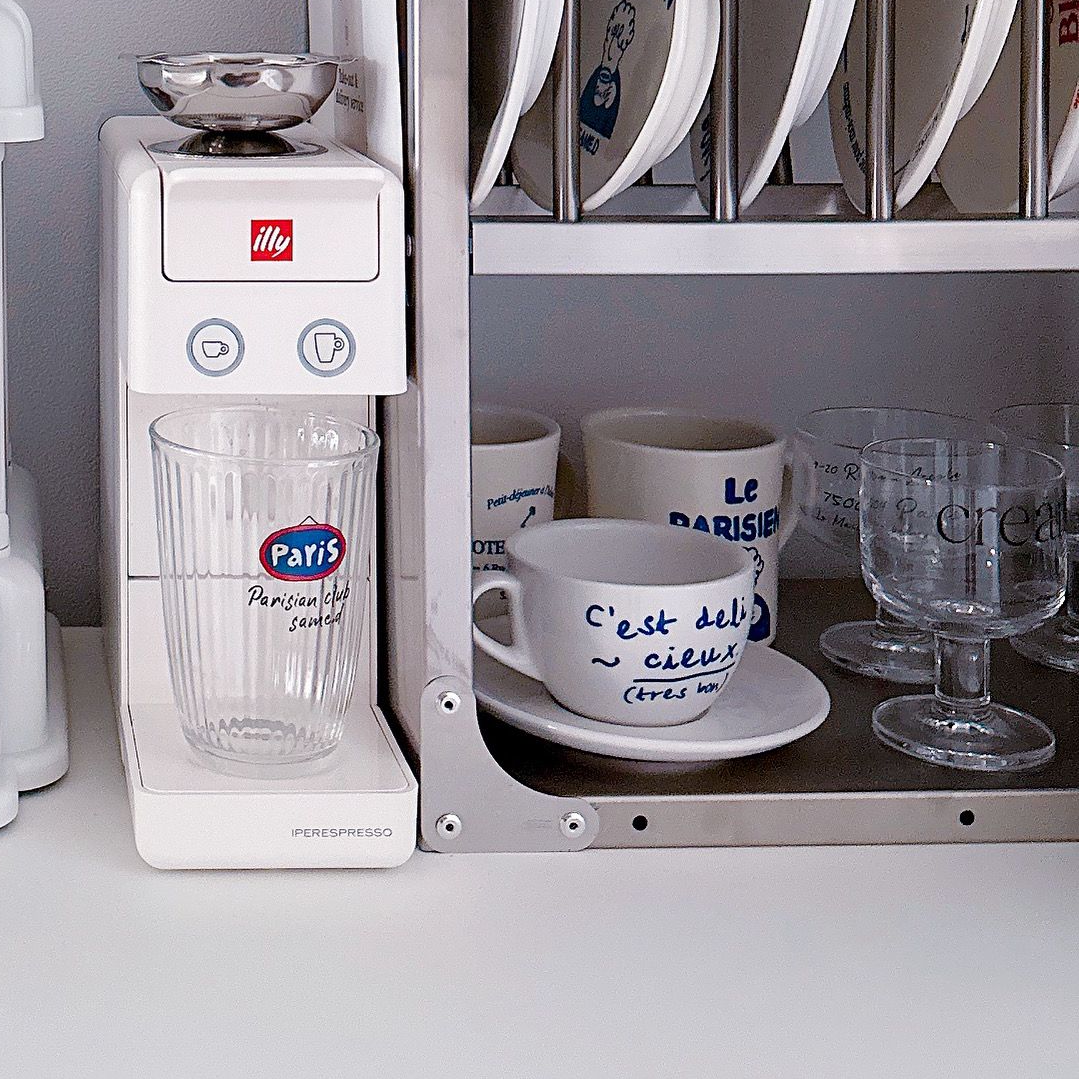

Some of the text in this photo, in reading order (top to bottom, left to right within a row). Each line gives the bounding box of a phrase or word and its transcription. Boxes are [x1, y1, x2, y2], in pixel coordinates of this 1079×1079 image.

[252, 225, 291, 258] illy
[725, 477, 758, 505] Le
[270, 537, 339, 568] Paris
[247, 578, 351, 612] Parisian club
[585, 597, 747, 640] C'est deli
[644, 642, 738, 671] cieux
[623, 686, 688, 704] (tres
[291, 827, 393, 838] IPERESPRESSO
